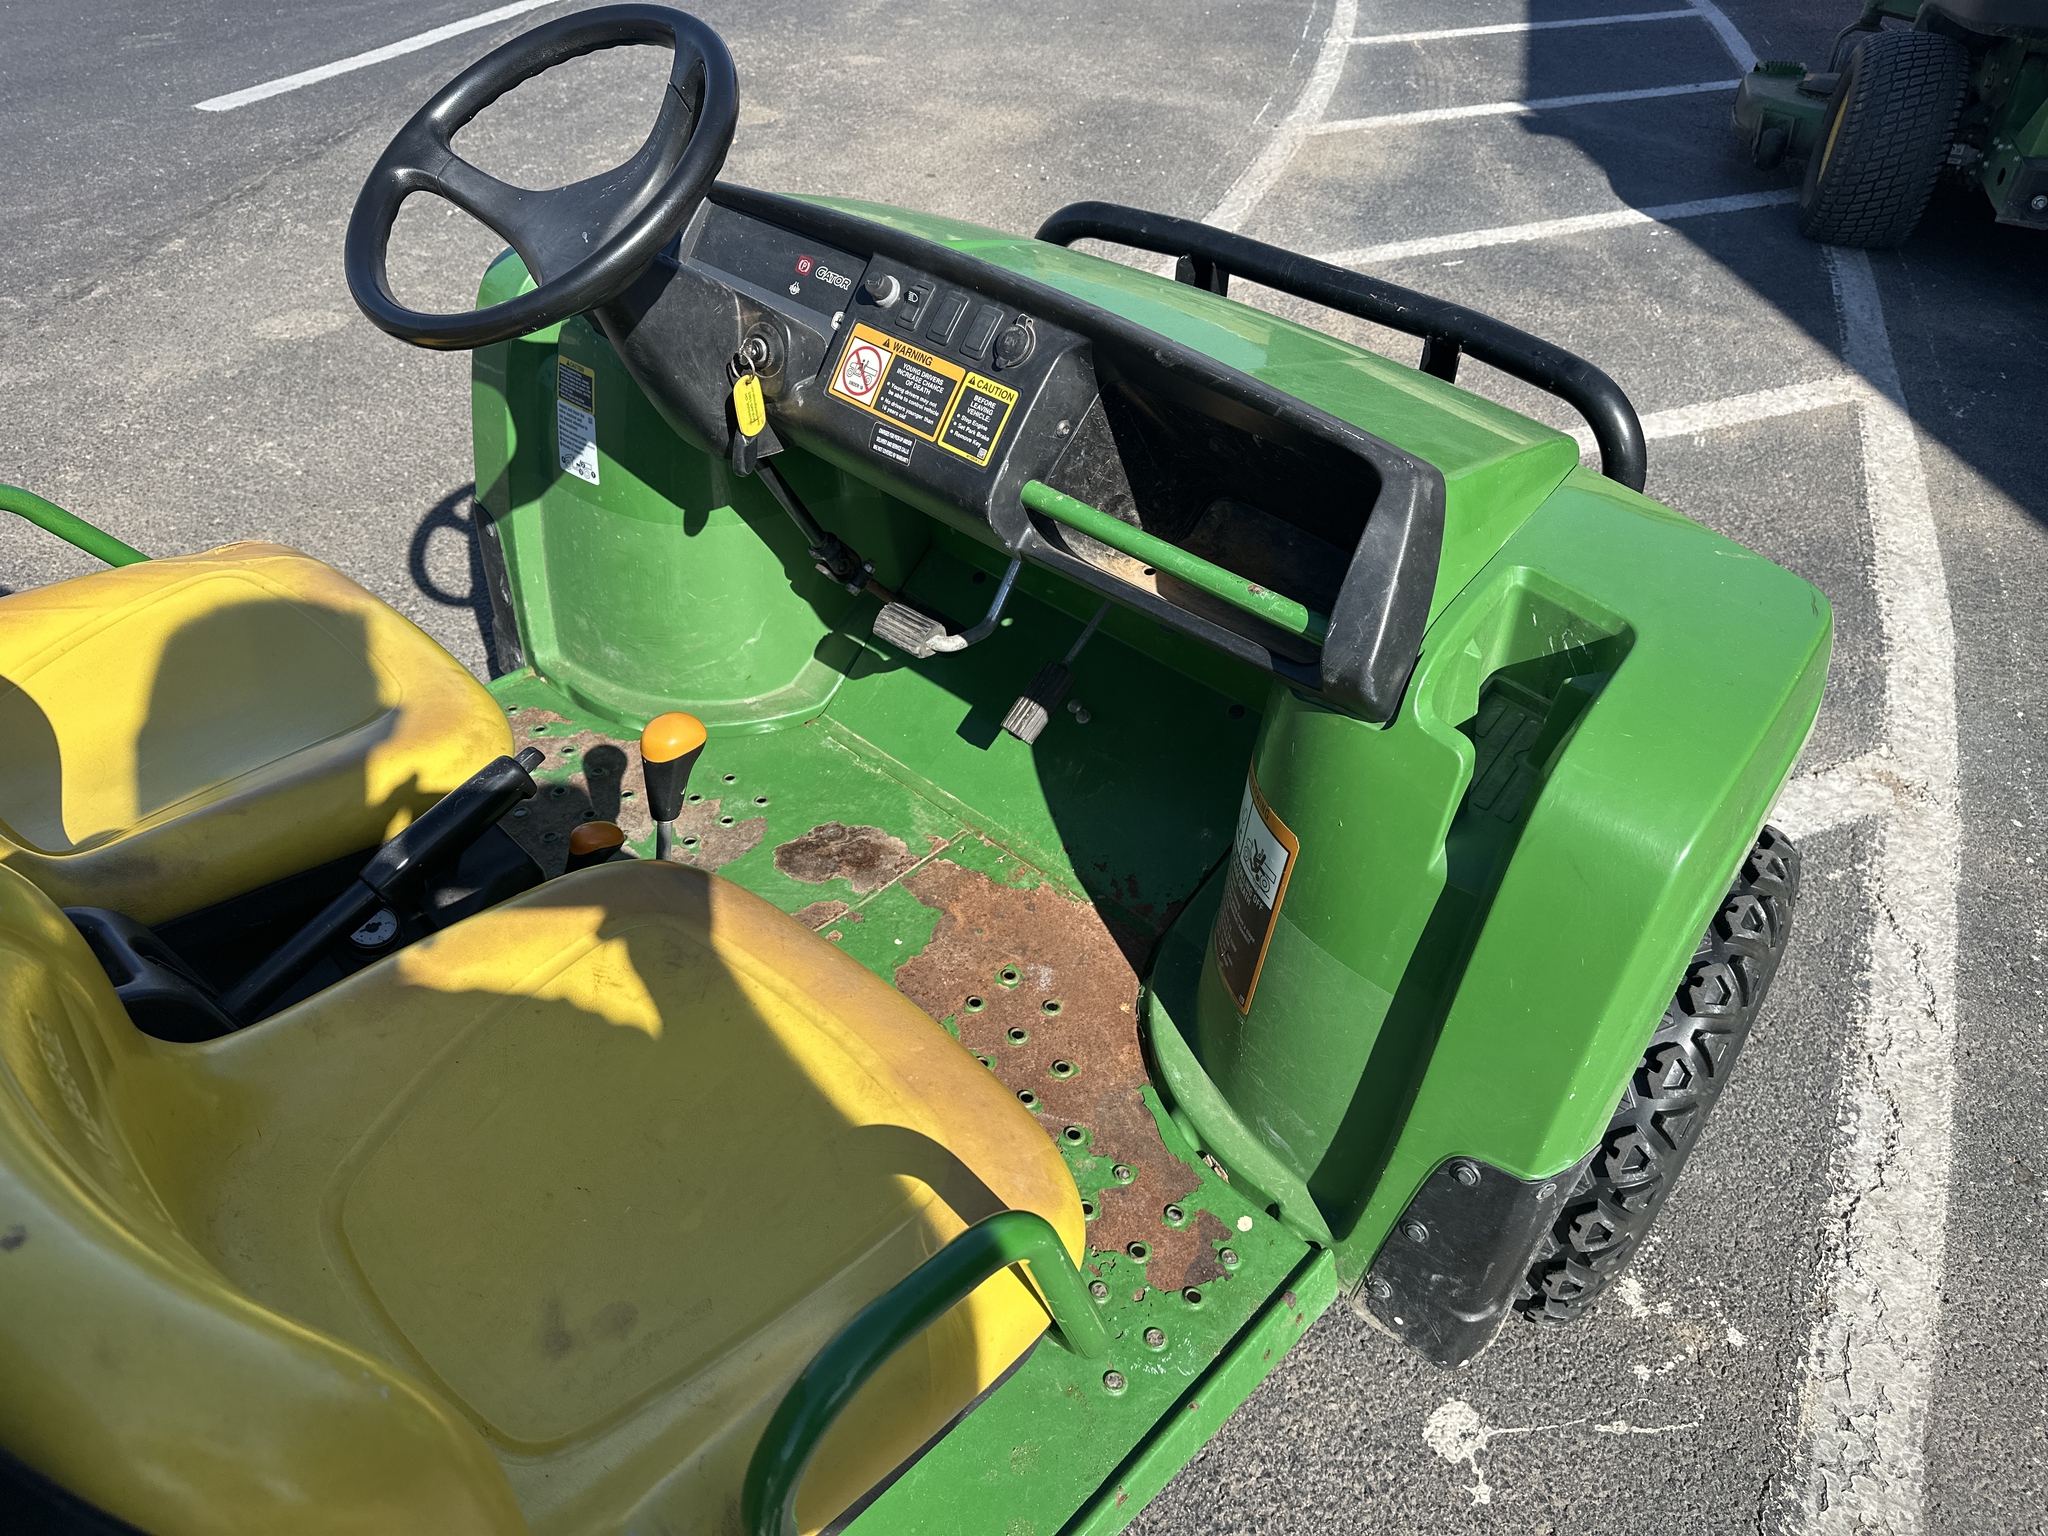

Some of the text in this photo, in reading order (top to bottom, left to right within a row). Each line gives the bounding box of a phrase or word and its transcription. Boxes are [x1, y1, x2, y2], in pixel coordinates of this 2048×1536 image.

[815, 265, 852, 291] GATOR
[892, 341, 934, 366] WARNING
[896, 368, 945, 394] INCREASE CHANCE
[903, 362, 944, 386] YOUNG DRIVERS
[891, 382, 938, 409] Young drivers may not
[913, 383, 931, 396] DEATH
[976, 379, 1015, 402] CAUTION
[894, 392, 904, 401] able
[908, 399, 925, 410] control
[924, 406, 940, 417] vehicle
[970, 401, 994, 416] LEAVING
[973, 394, 997, 410] BEFORE
[886, 408, 899, 417] years
[898, 412, 907, 420] old
[891, 400, 906, 412] drivers
[905, 408, 924, 419] younger
[923, 416, 934, 426] than
[961, 414, 988, 432] Stop Engine
[967, 407, 992, 423] VEHICLE:
[953, 430, 982, 449] Remove Key
[957, 422, 990, 442] Set Park Brake
[1252, 894, 1264, 910] OFF
